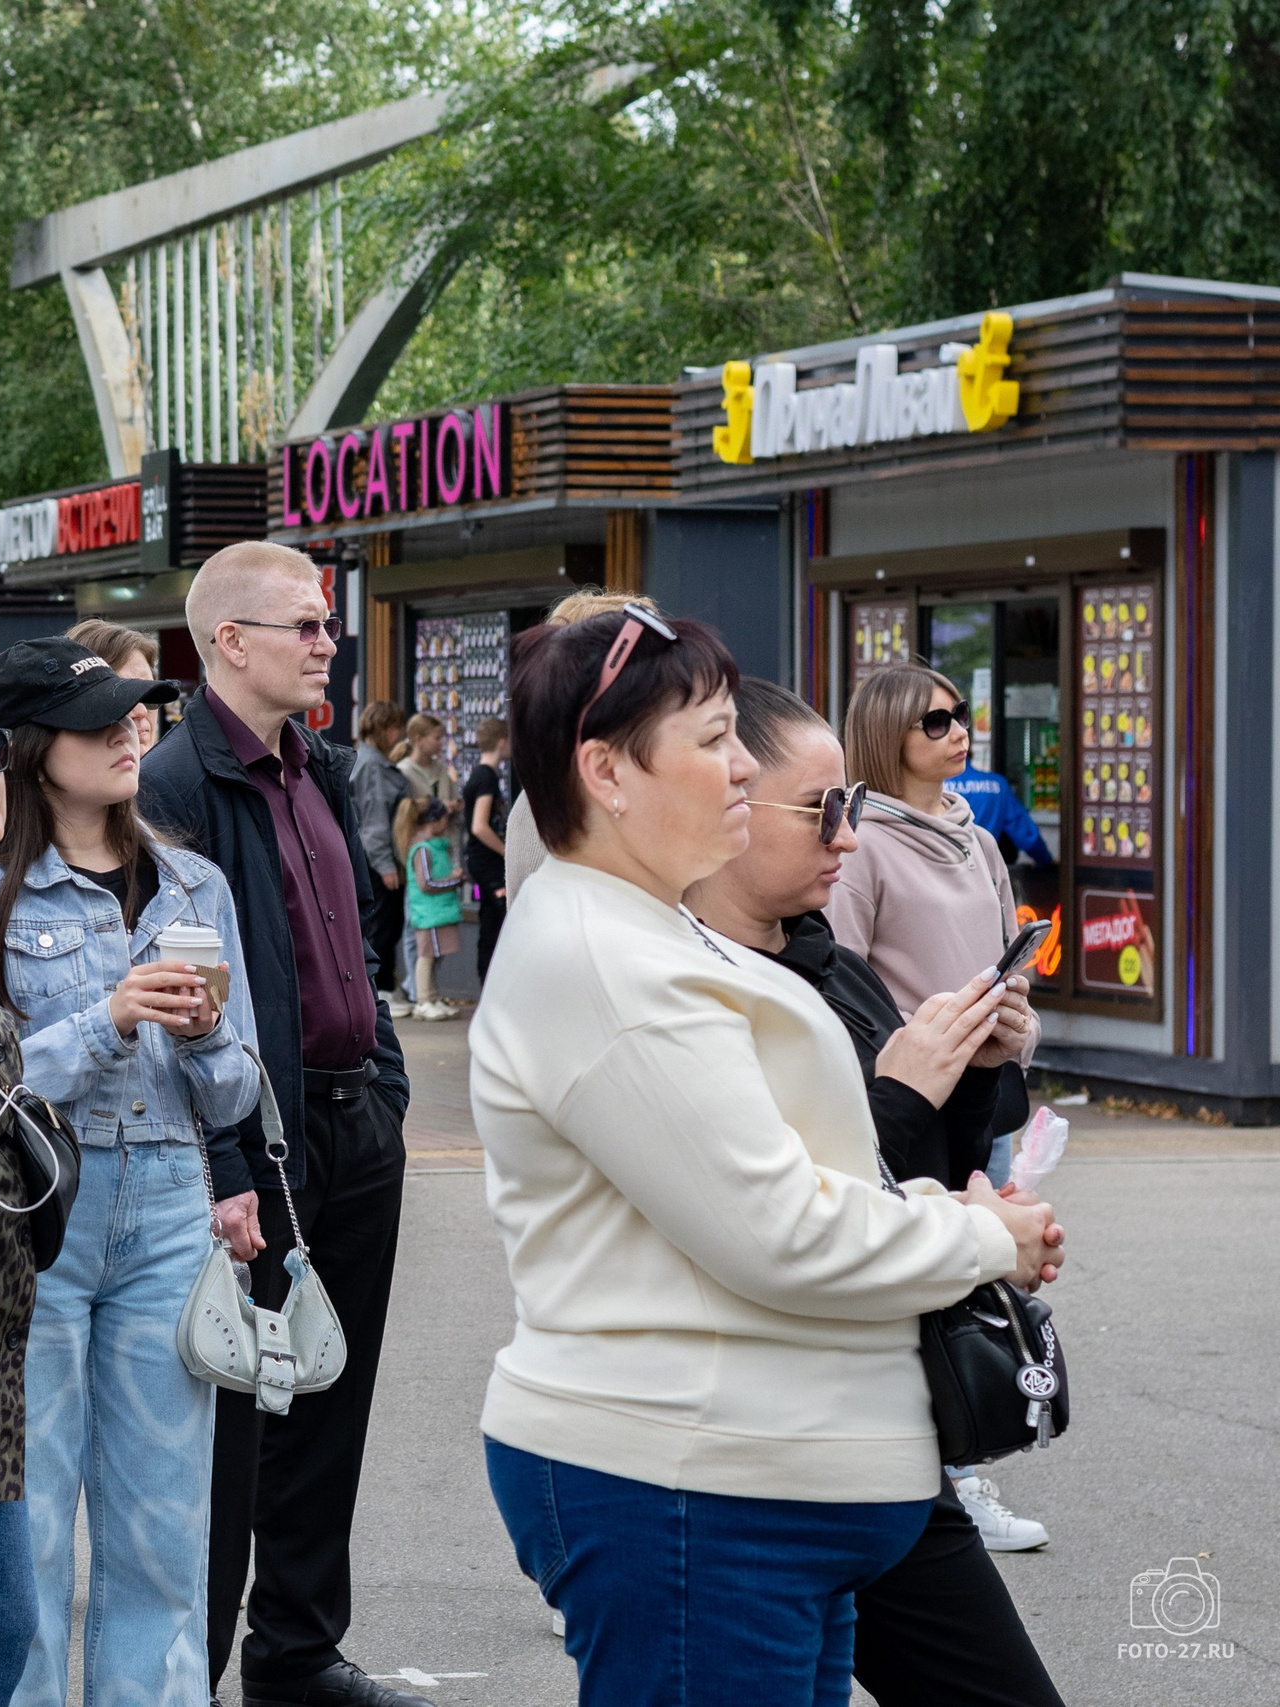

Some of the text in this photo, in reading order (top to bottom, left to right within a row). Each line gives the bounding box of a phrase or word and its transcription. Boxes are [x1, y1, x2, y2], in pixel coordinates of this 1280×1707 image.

[283, 403, 501, 527] LOCATION
[57, 482, 141, 554] ВСТРЕЧИ
[1083, 915, 1136, 947] МЕГАДОГ
